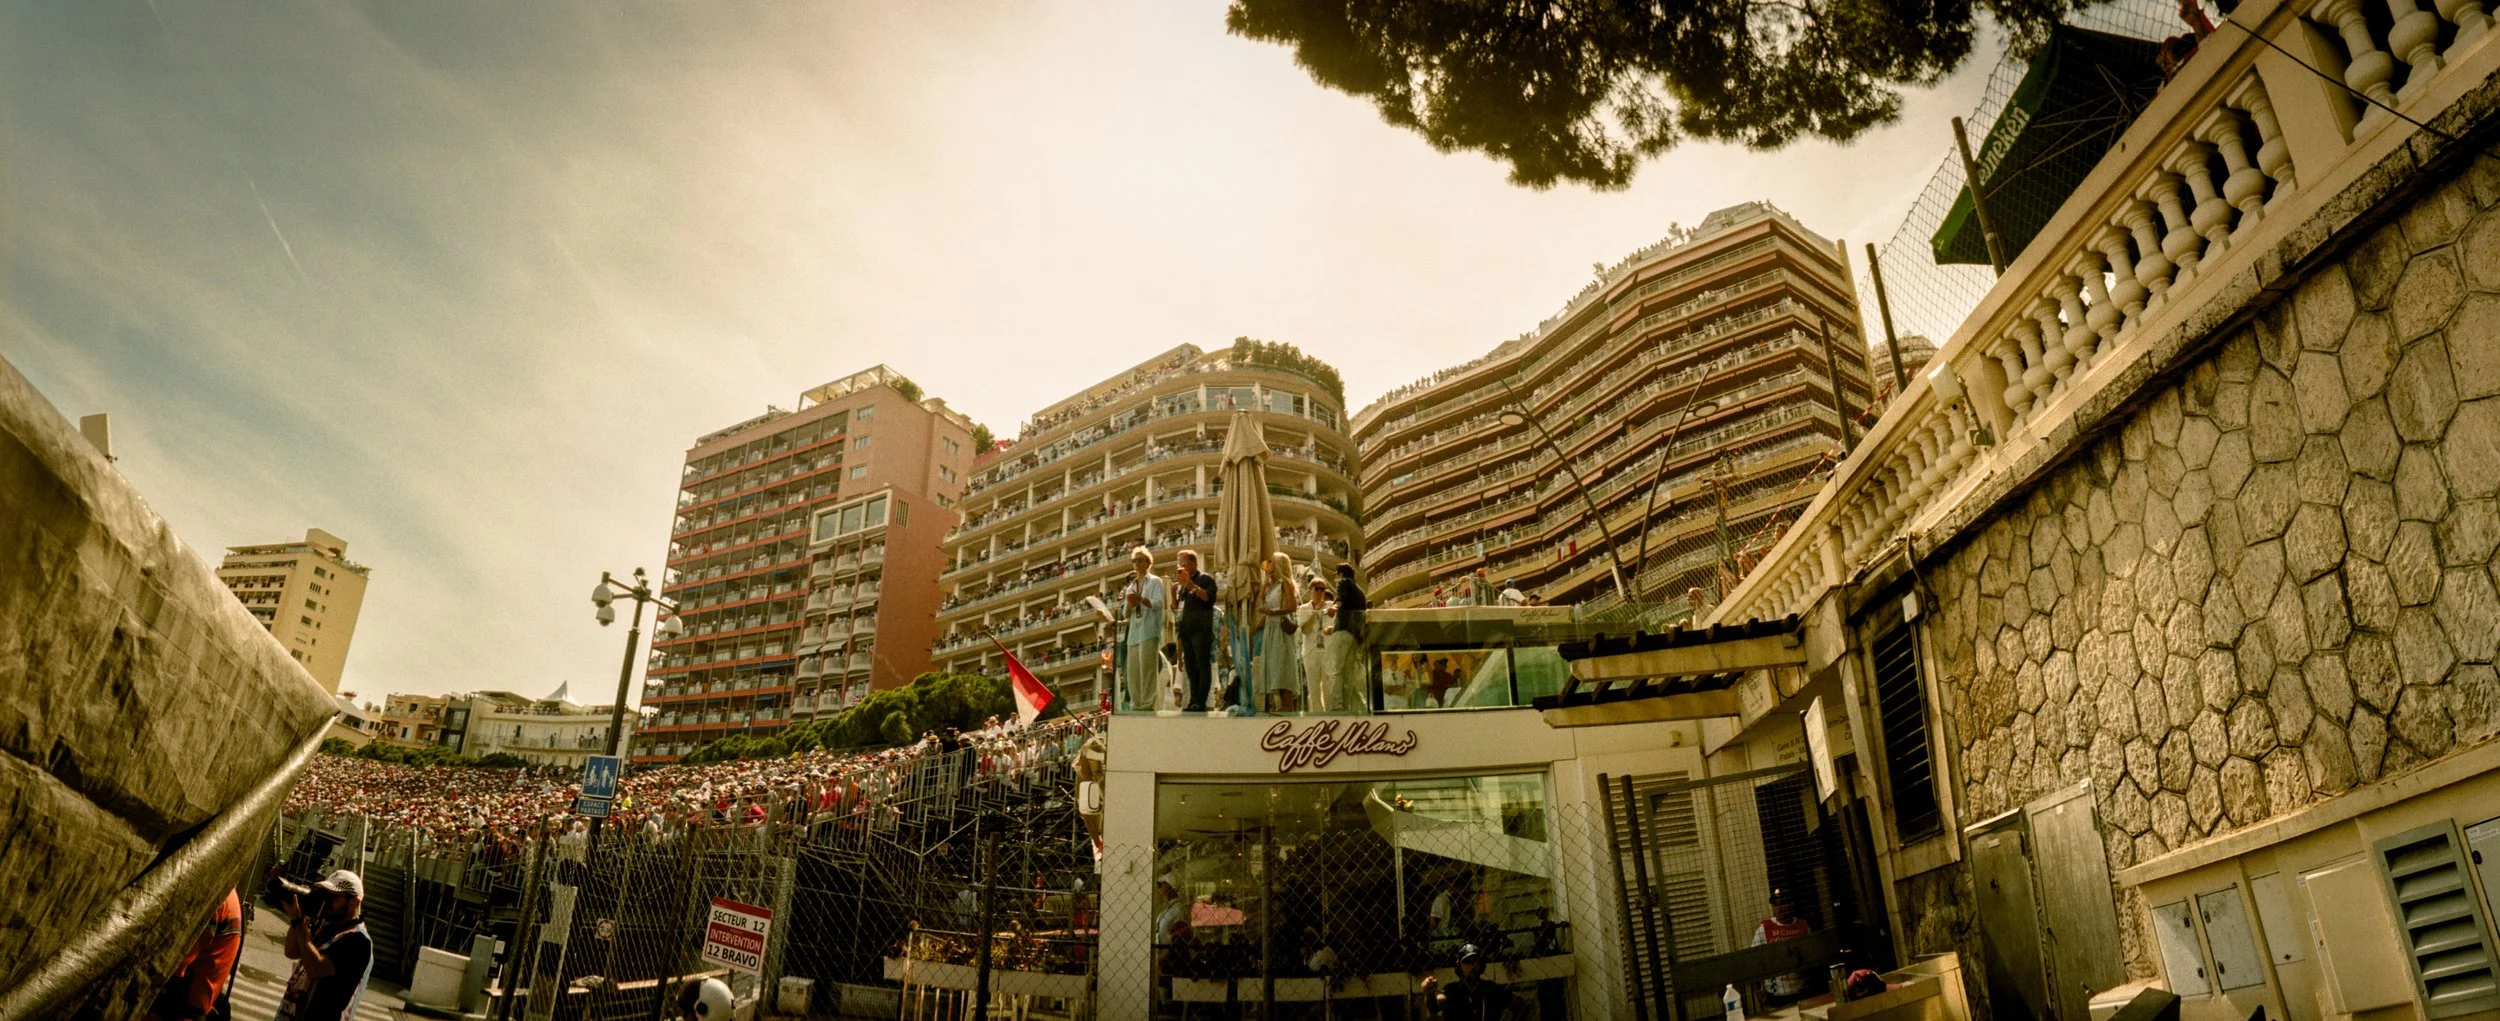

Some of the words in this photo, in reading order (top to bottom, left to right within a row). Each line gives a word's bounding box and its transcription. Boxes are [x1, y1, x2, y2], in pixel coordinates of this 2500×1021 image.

[1976, 106, 2031, 187] eineken
[1261, 720, 1340, 773] Caffé
[1313, 720, 1418, 769] Milano
[713, 911, 747, 928] SECTEUR
[753, 921, 765, 932] 12
[710, 928, 761, 951] INTERVENTION
[708, 945, 720, 957] 12
[722, 948, 757, 967] BRAVO
